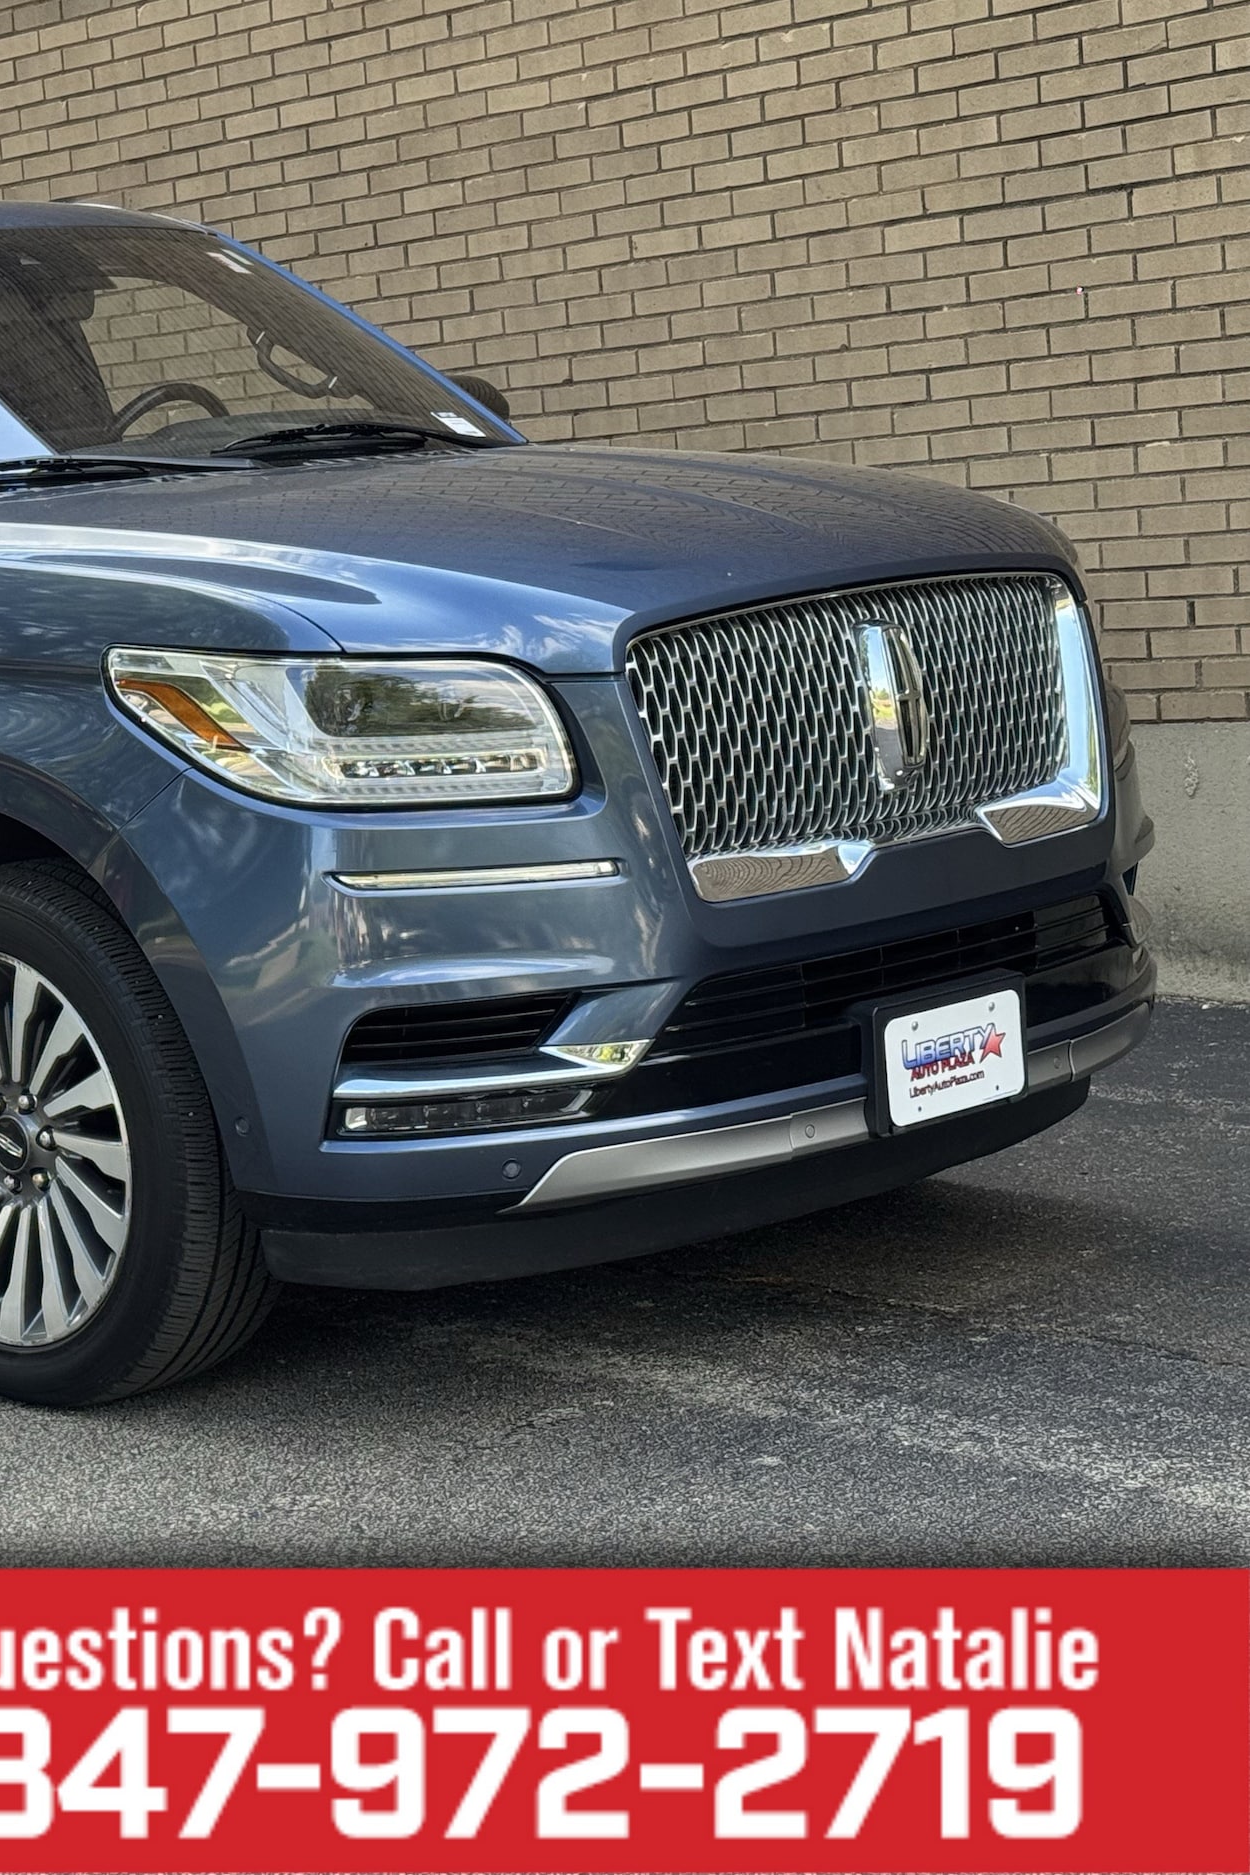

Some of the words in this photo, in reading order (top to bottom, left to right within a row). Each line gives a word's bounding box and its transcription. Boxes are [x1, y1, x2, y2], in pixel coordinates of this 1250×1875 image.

[901, 1022, 997, 1071] LIBERTY
[910, 1061, 939, 1082] AUTO
[941, 1052, 975, 1074] PLAZA
[909, 1069, 985, 1099] LibertyAutoPlaza.com
